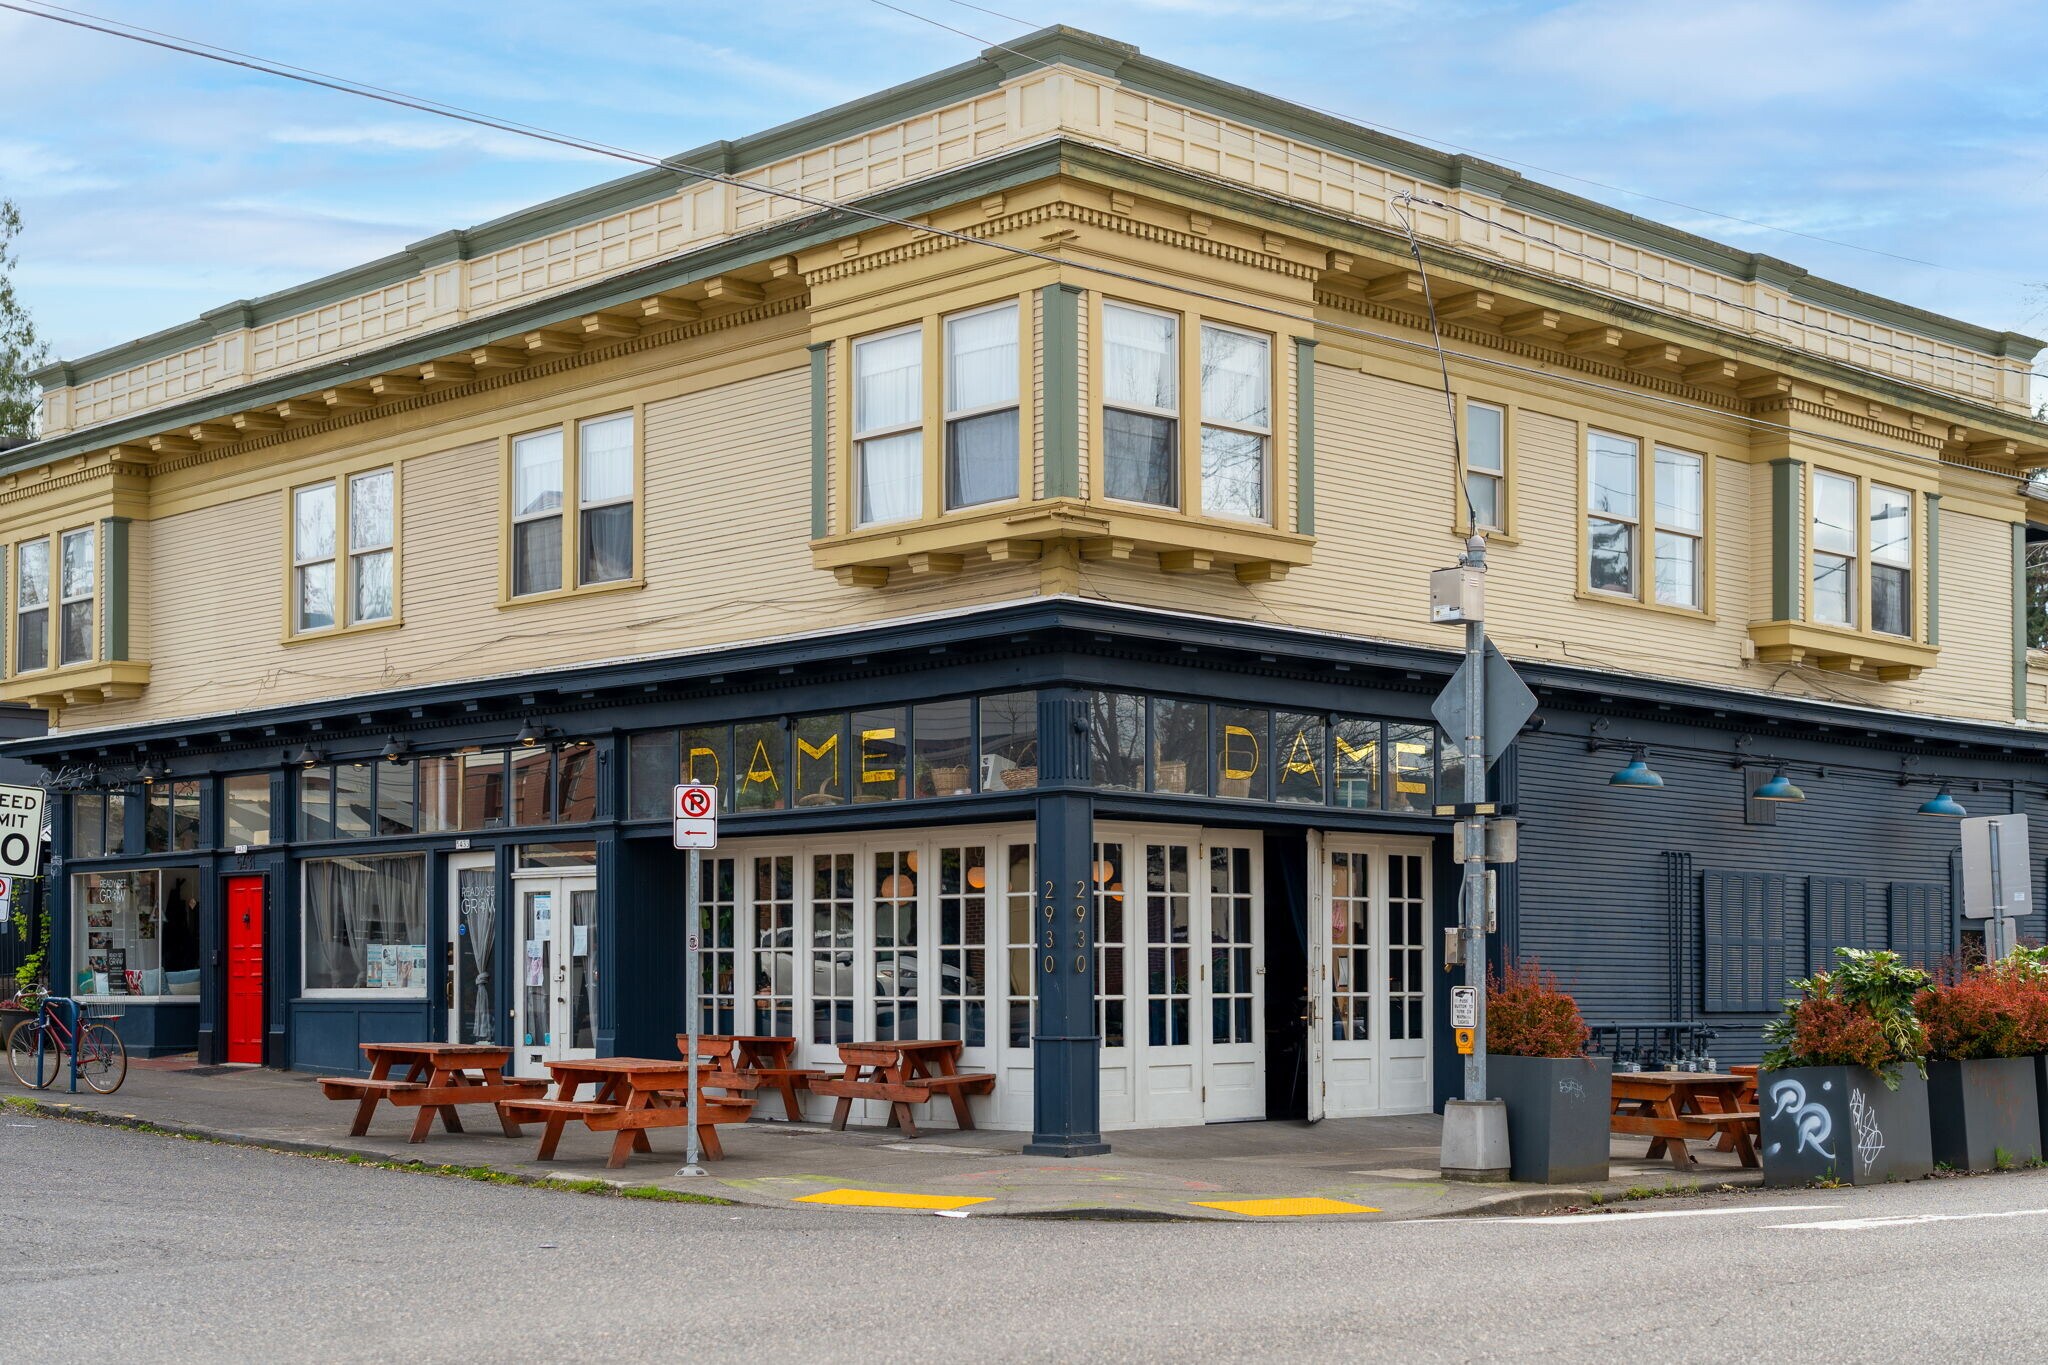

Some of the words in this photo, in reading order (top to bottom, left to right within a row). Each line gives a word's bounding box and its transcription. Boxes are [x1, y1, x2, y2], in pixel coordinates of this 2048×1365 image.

[689, 727, 896, 794] DAME
[1225, 725, 1427, 794] DAME
[0, 793, 37, 810] EED
[0, 813, 29, 828] MIT
[0, 832, 30, 867] 0
[461, 886, 484, 897] READY
[485, 885, 496, 897] SE
